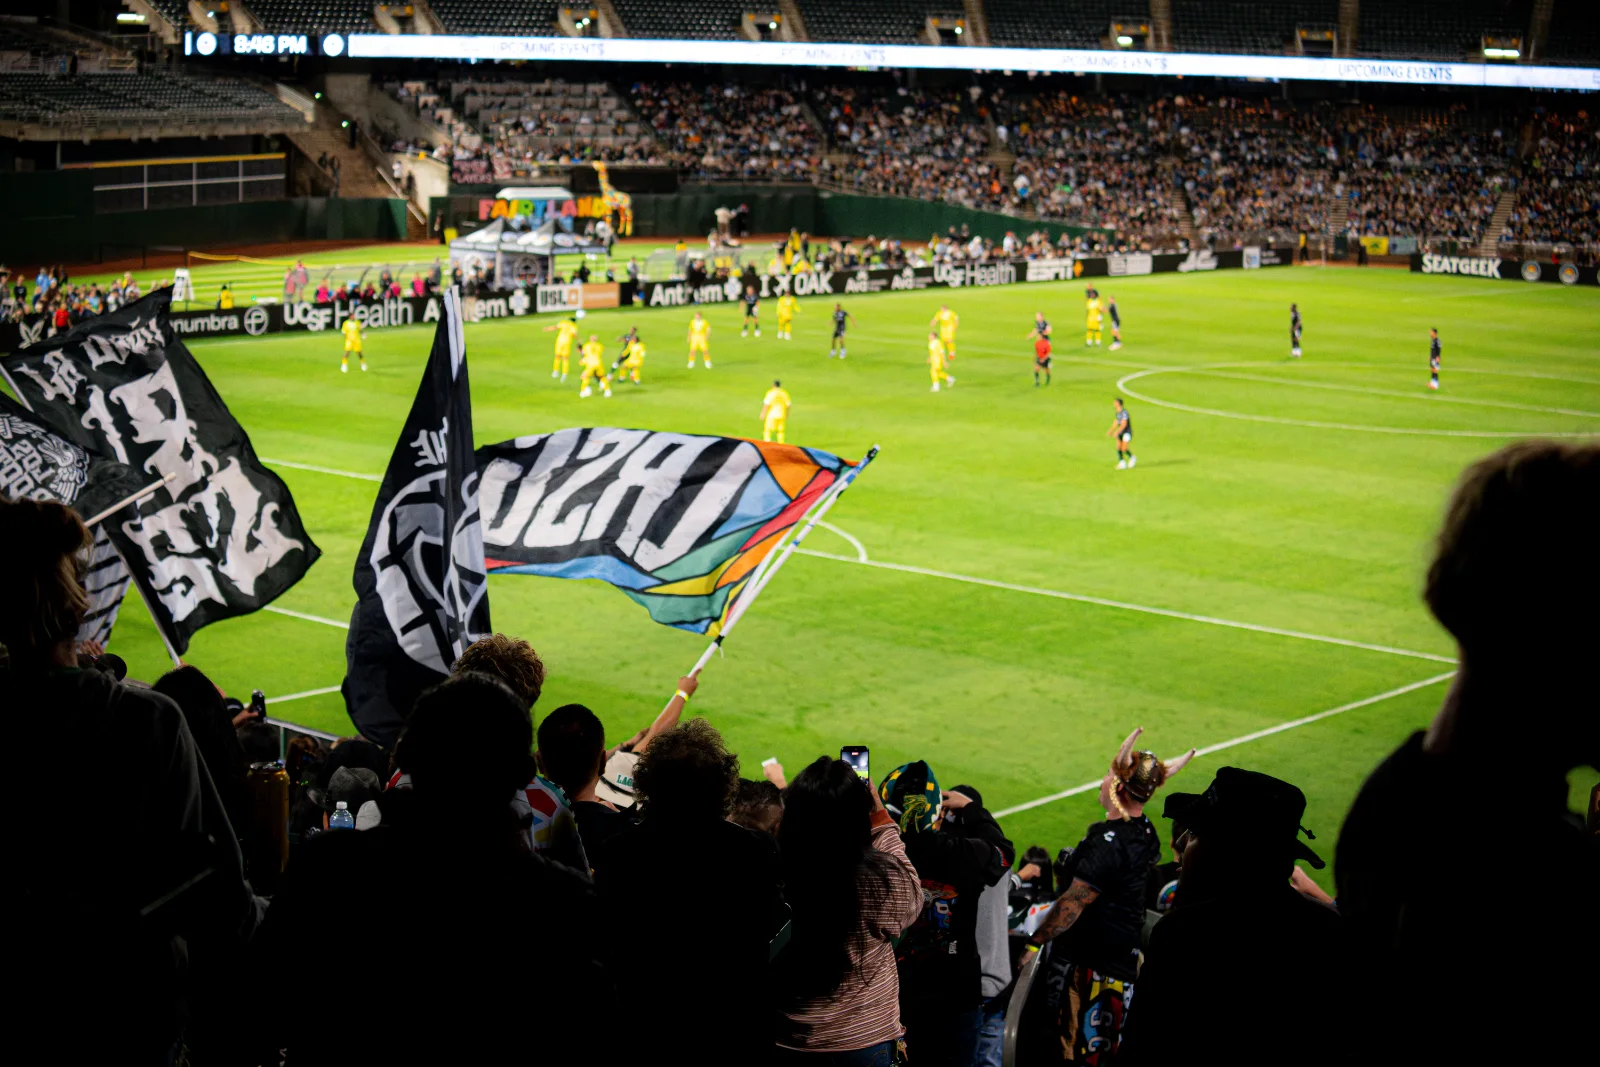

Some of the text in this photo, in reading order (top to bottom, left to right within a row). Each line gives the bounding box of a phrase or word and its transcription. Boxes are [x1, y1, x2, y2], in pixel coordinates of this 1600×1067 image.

[278, 35, 308, 54] PM
[559, 42, 605, 56] EVENTS
[775, 48, 837, 61] PCOMING
[1056, 56, 1119, 69] PCOMING
[1338, 63, 1453, 81] UPCOMING EVENTS
[479, 196, 607, 221] FAIRYLAND
[965, 259, 1017, 286] Health
[1027, 257, 1074, 282] ESPN
[1421, 253, 1502, 280] SEATGEEK
[650, 282, 724, 307] Antem
[794, 271, 833, 296] OAK
[283, 299, 413, 332] UCSF Health
